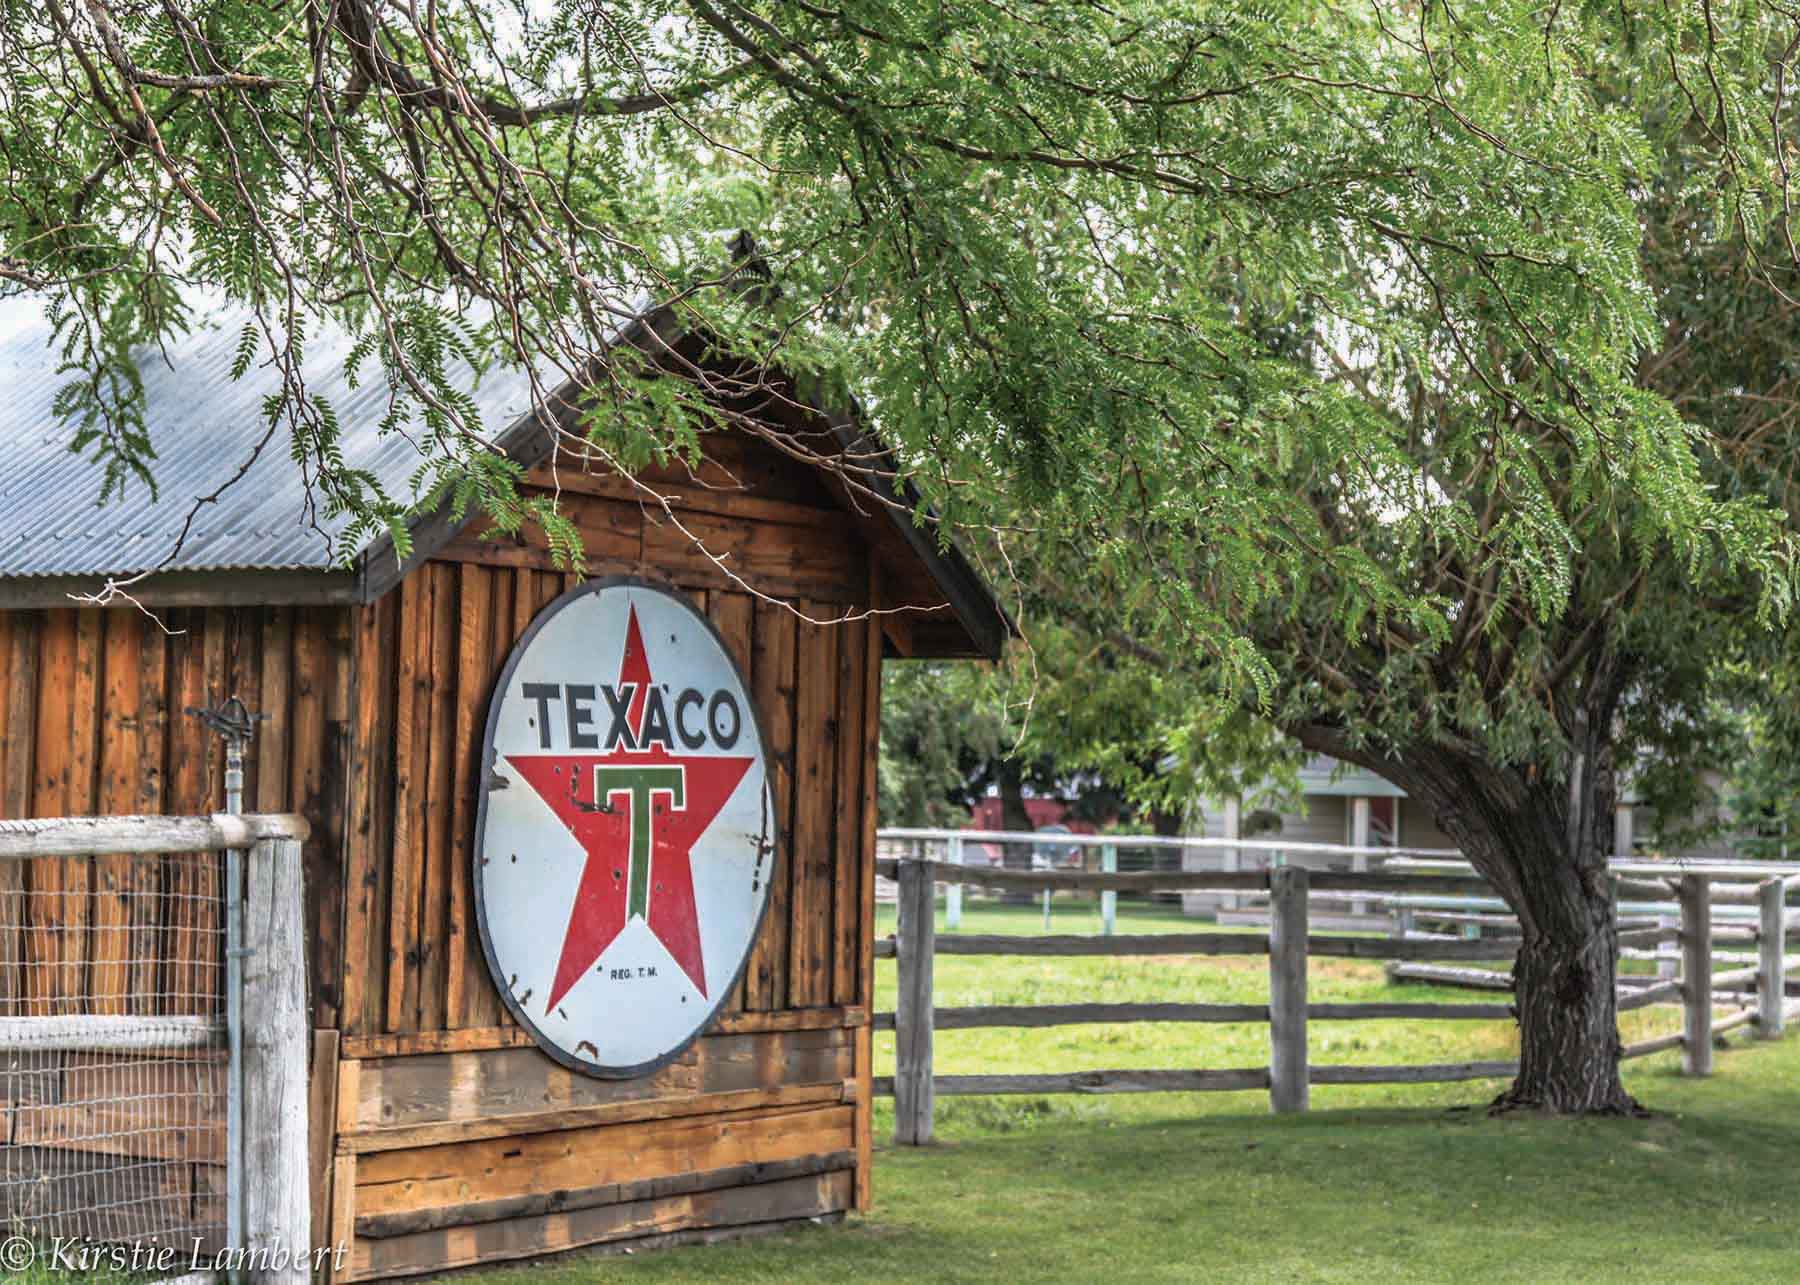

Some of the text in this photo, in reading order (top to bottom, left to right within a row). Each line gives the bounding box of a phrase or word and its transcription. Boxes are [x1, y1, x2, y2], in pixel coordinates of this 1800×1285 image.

[521, 682, 741, 751] TEXACO
[594, 765, 687, 922] T
[610, 968, 632, 980] REG.
